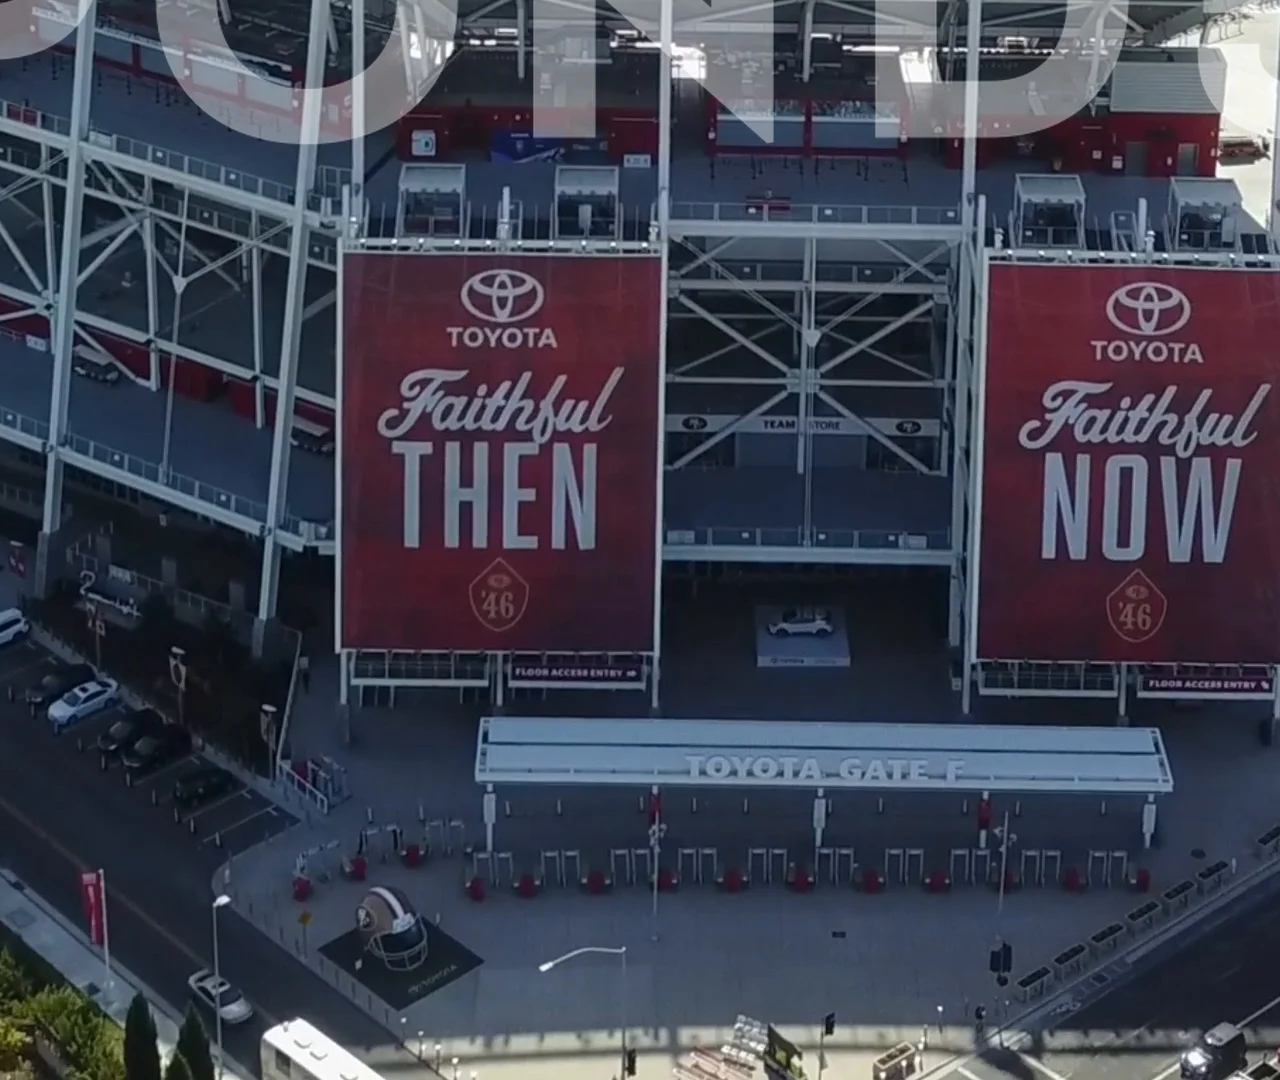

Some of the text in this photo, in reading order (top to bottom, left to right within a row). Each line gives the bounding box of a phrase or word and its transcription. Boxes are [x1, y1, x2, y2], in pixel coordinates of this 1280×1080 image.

[446, 327, 558, 349] TOYOTA
[1090, 340, 1204, 364] TOYOTA
[377, 366, 625, 445] Faithful
[762, 419, 796, 430] TEAM
[1018, 380, 1272, 459] Faithful
[391, 440, 597, 551] THEN
[1041, 452, 1243, 564] NOW
[515, 667, 623, 678] FLOOR ACCESS ENTRY
[1148, 680, 1257, 690] FLOOR ACCESS ENTRY
[685, 755, 966, 782] TOYOTA GATE F
